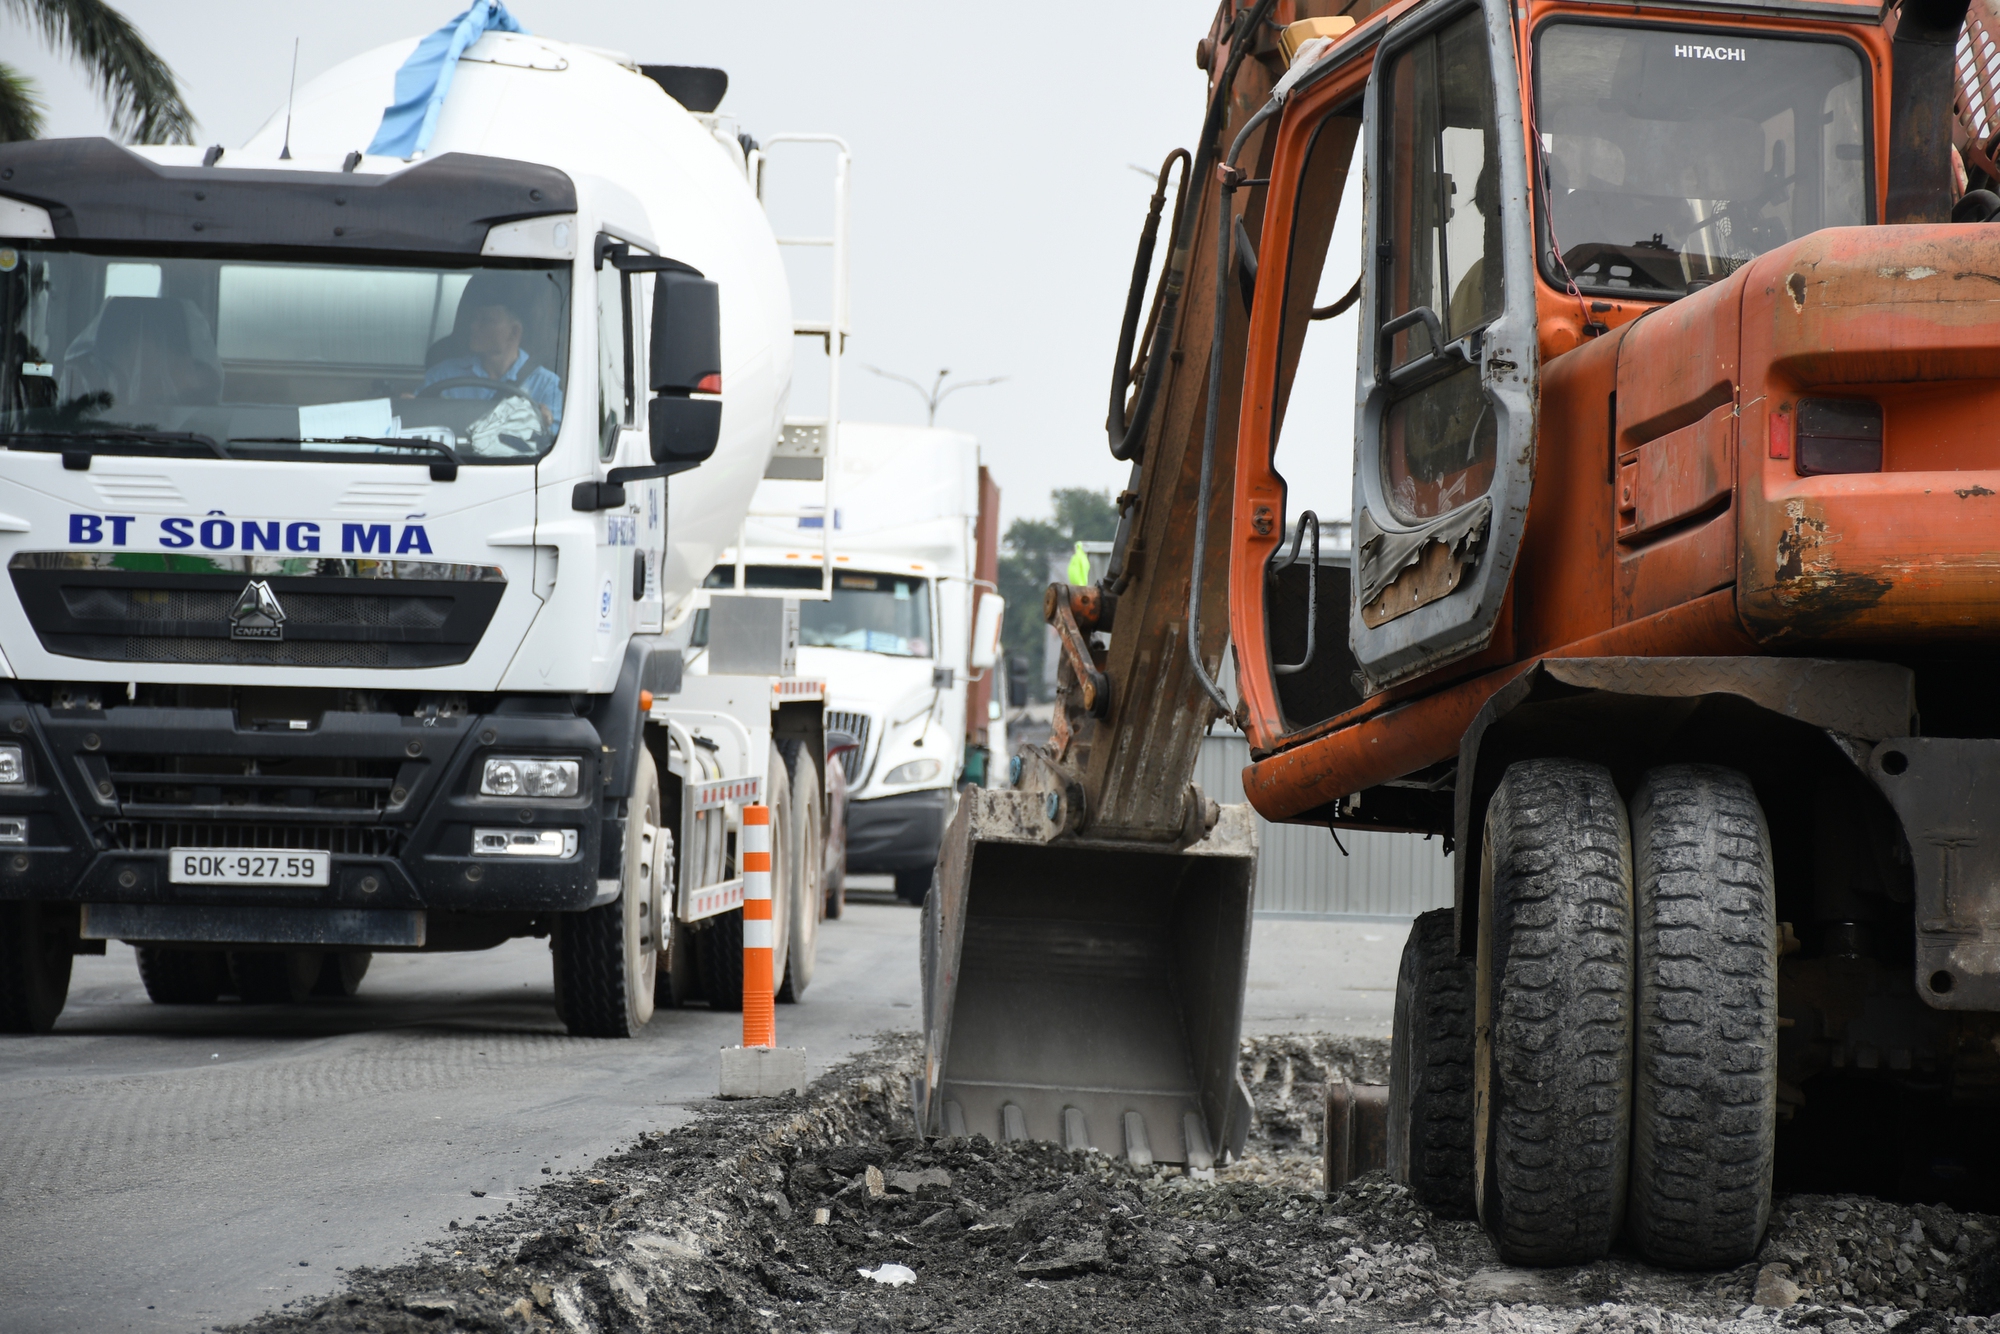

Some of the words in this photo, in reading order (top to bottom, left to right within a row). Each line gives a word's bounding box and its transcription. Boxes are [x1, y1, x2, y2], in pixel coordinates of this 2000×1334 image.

[1674, 44, 1746, 62] HITACHI
[68, 513, 136, 547] BT
[158, 510, 321, 552] SÔNG
[341, 512, 434, 554] MÃ
[234, 627, 279, 637] CNHTC
[184, 856, 315, 878] 60K-927.59
